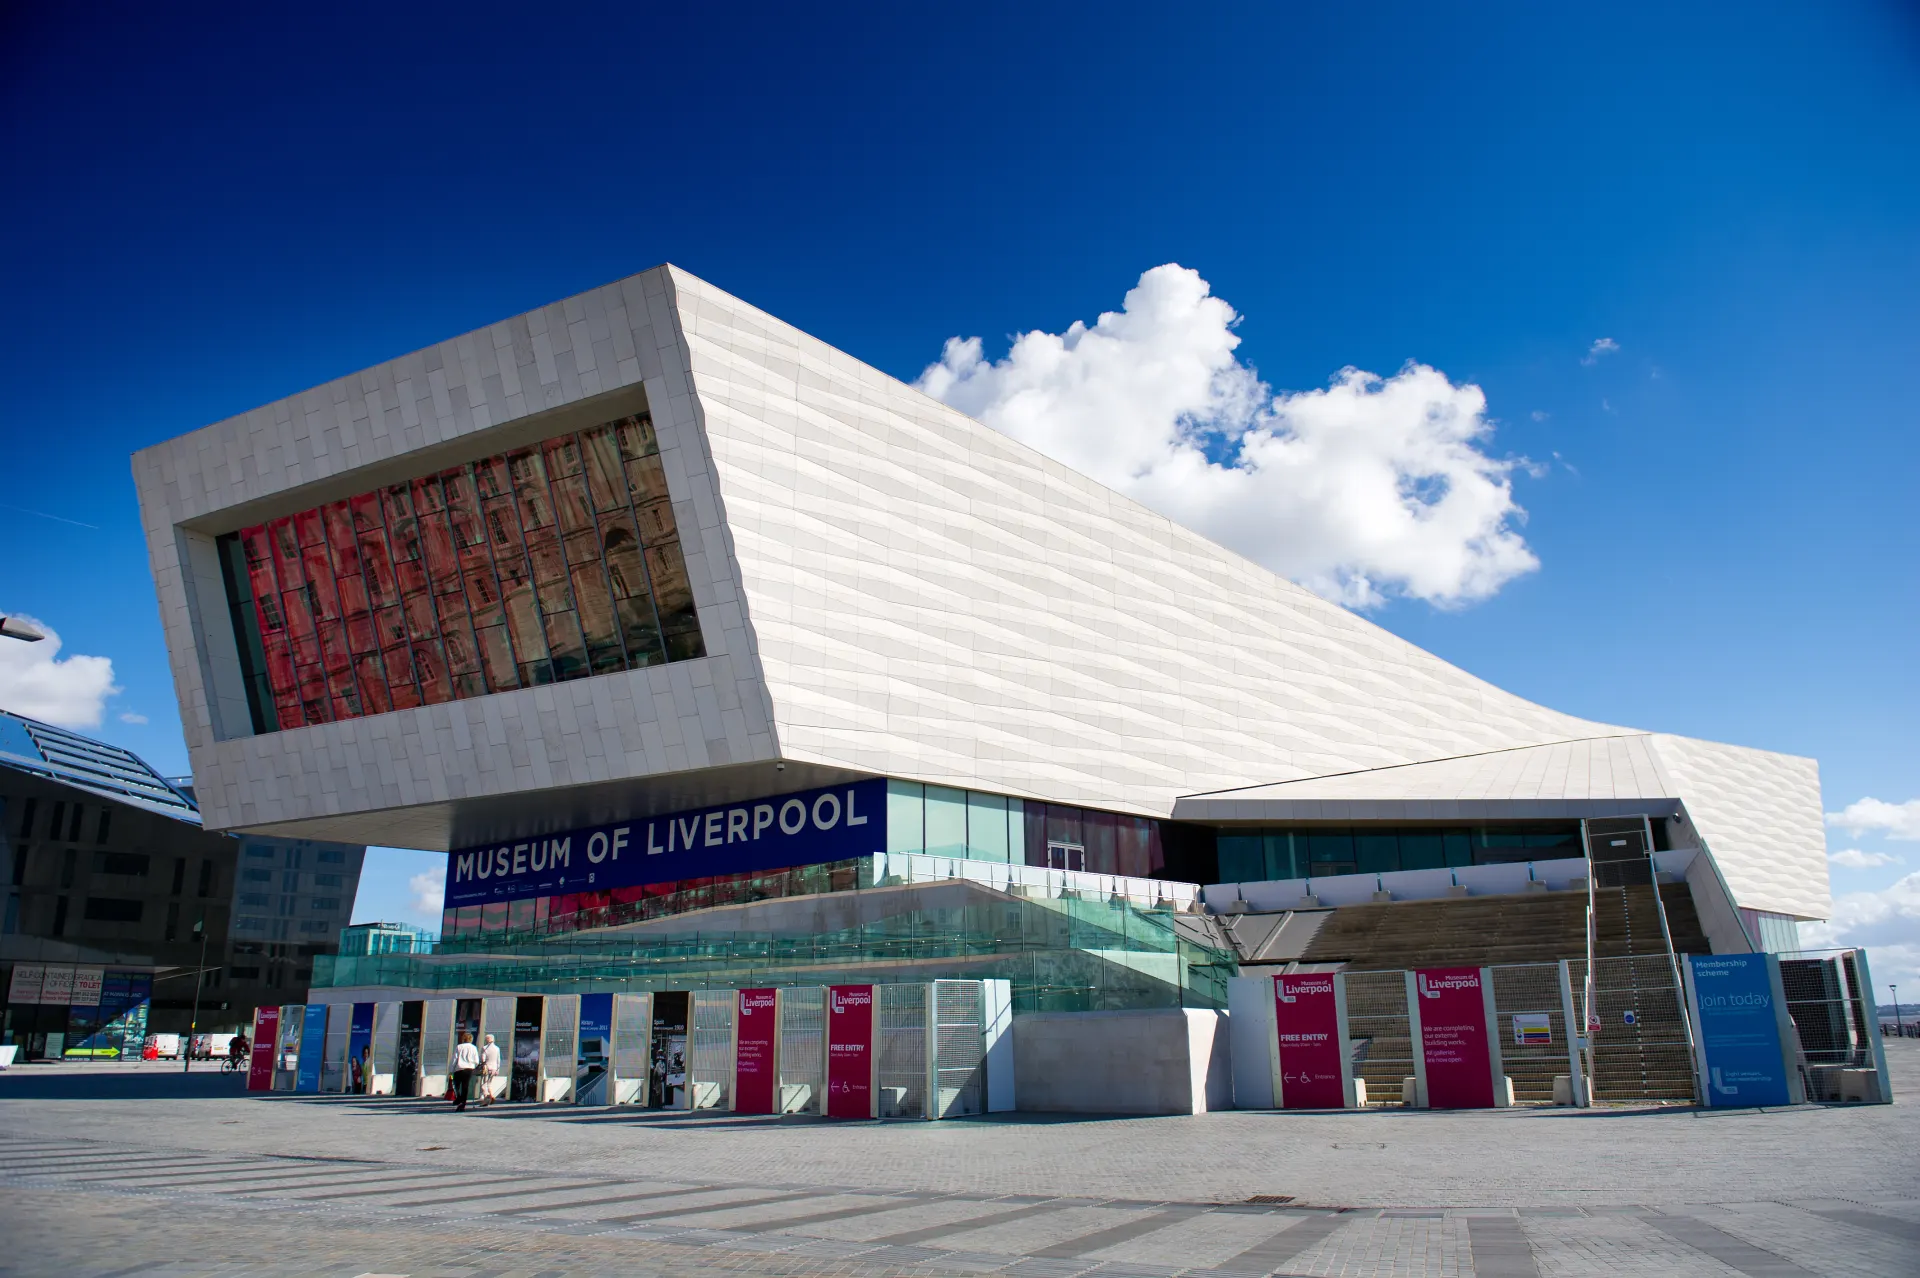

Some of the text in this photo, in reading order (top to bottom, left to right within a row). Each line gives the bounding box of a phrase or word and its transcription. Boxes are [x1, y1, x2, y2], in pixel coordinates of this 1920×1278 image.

[456, 790, 868, 883] MUSEUM OF LIVERPOOL
[1696, 960, 1747, 969] Membership
[79, 981, 87, 989] TO
[88, 981, 101, 989] LET
[1286, 983, 1332, 995] Liverpool
[1429, 978, 1479, 990] Liverpool
[745, 997, 774, 1008] Liverpool
[838, 995, 871, 1006] Liverpool
[1700, 993, 1726, 1010] Join
[1730, 991, 1769, 1008] today
[1443, 1025, 1474, 1033] completing
[1302, 1033, 1328, 1041] ENTRY
[845, 1044, 864, 1052] ENTRY
